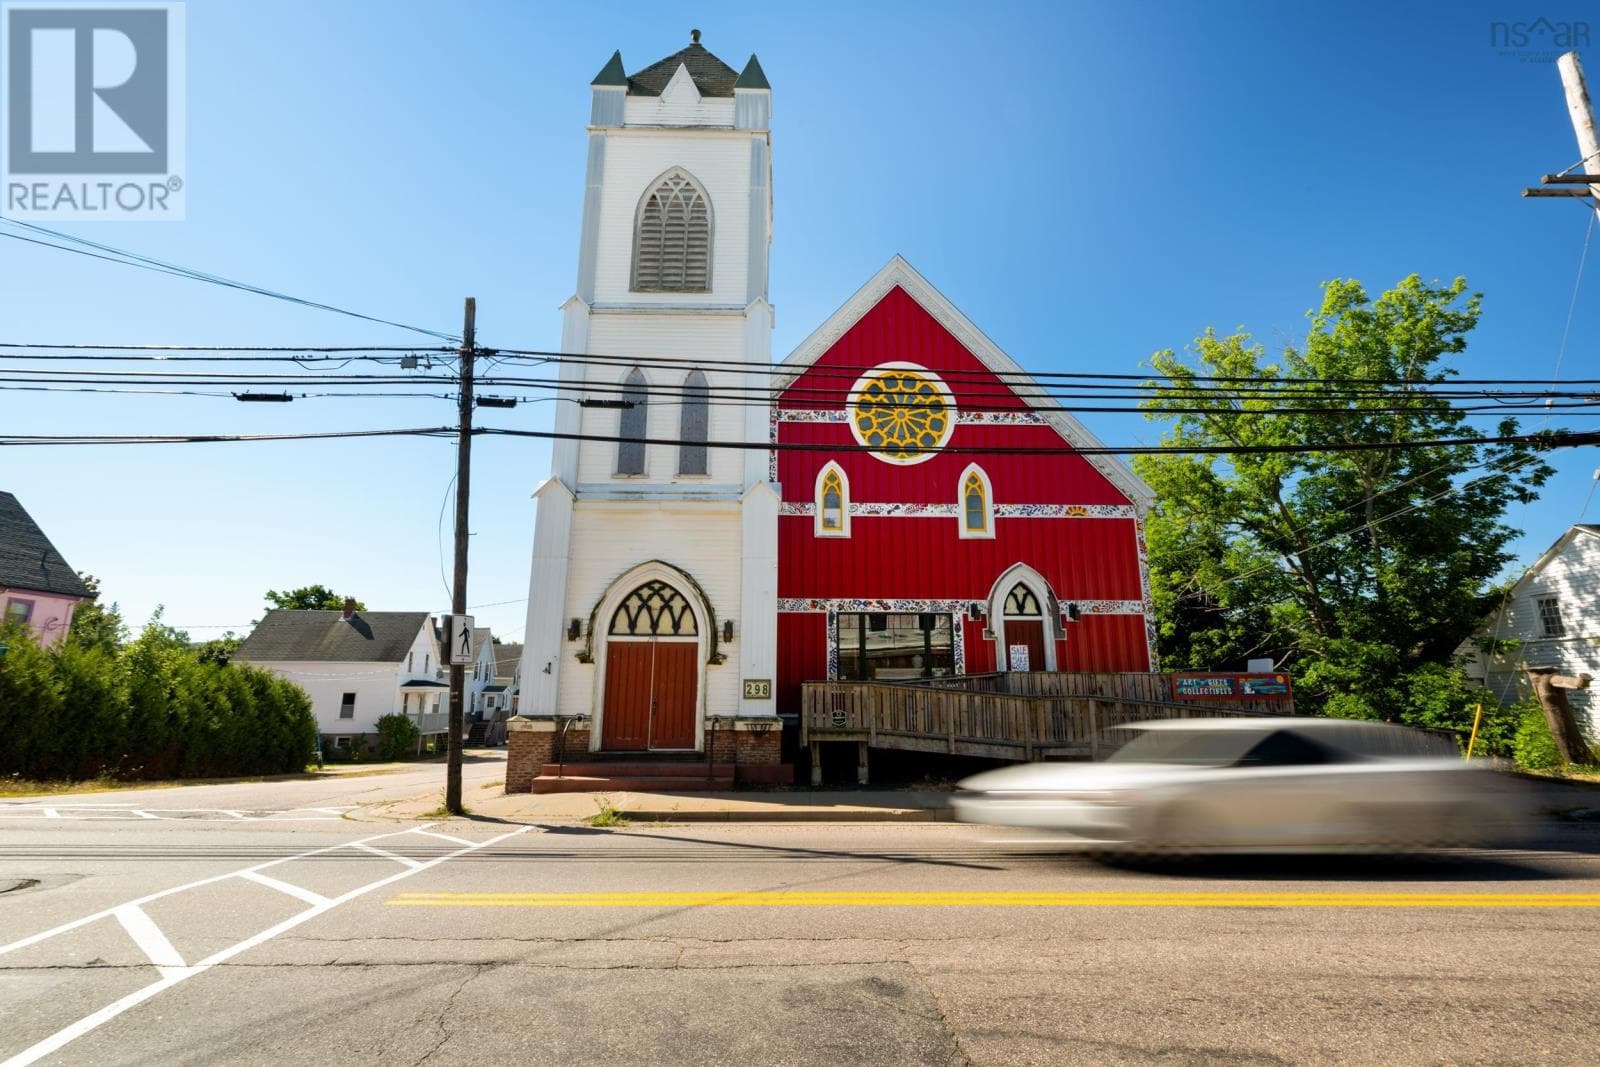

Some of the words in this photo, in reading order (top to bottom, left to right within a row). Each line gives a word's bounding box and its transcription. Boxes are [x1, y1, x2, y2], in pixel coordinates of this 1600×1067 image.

[1183, 679, 1197, 687] ART
[1208, 679, 1228, 687] GIFTS
[746, 684, 768, 695] 298
[1182, 687, 1233, 695] COLLECTIBLES
